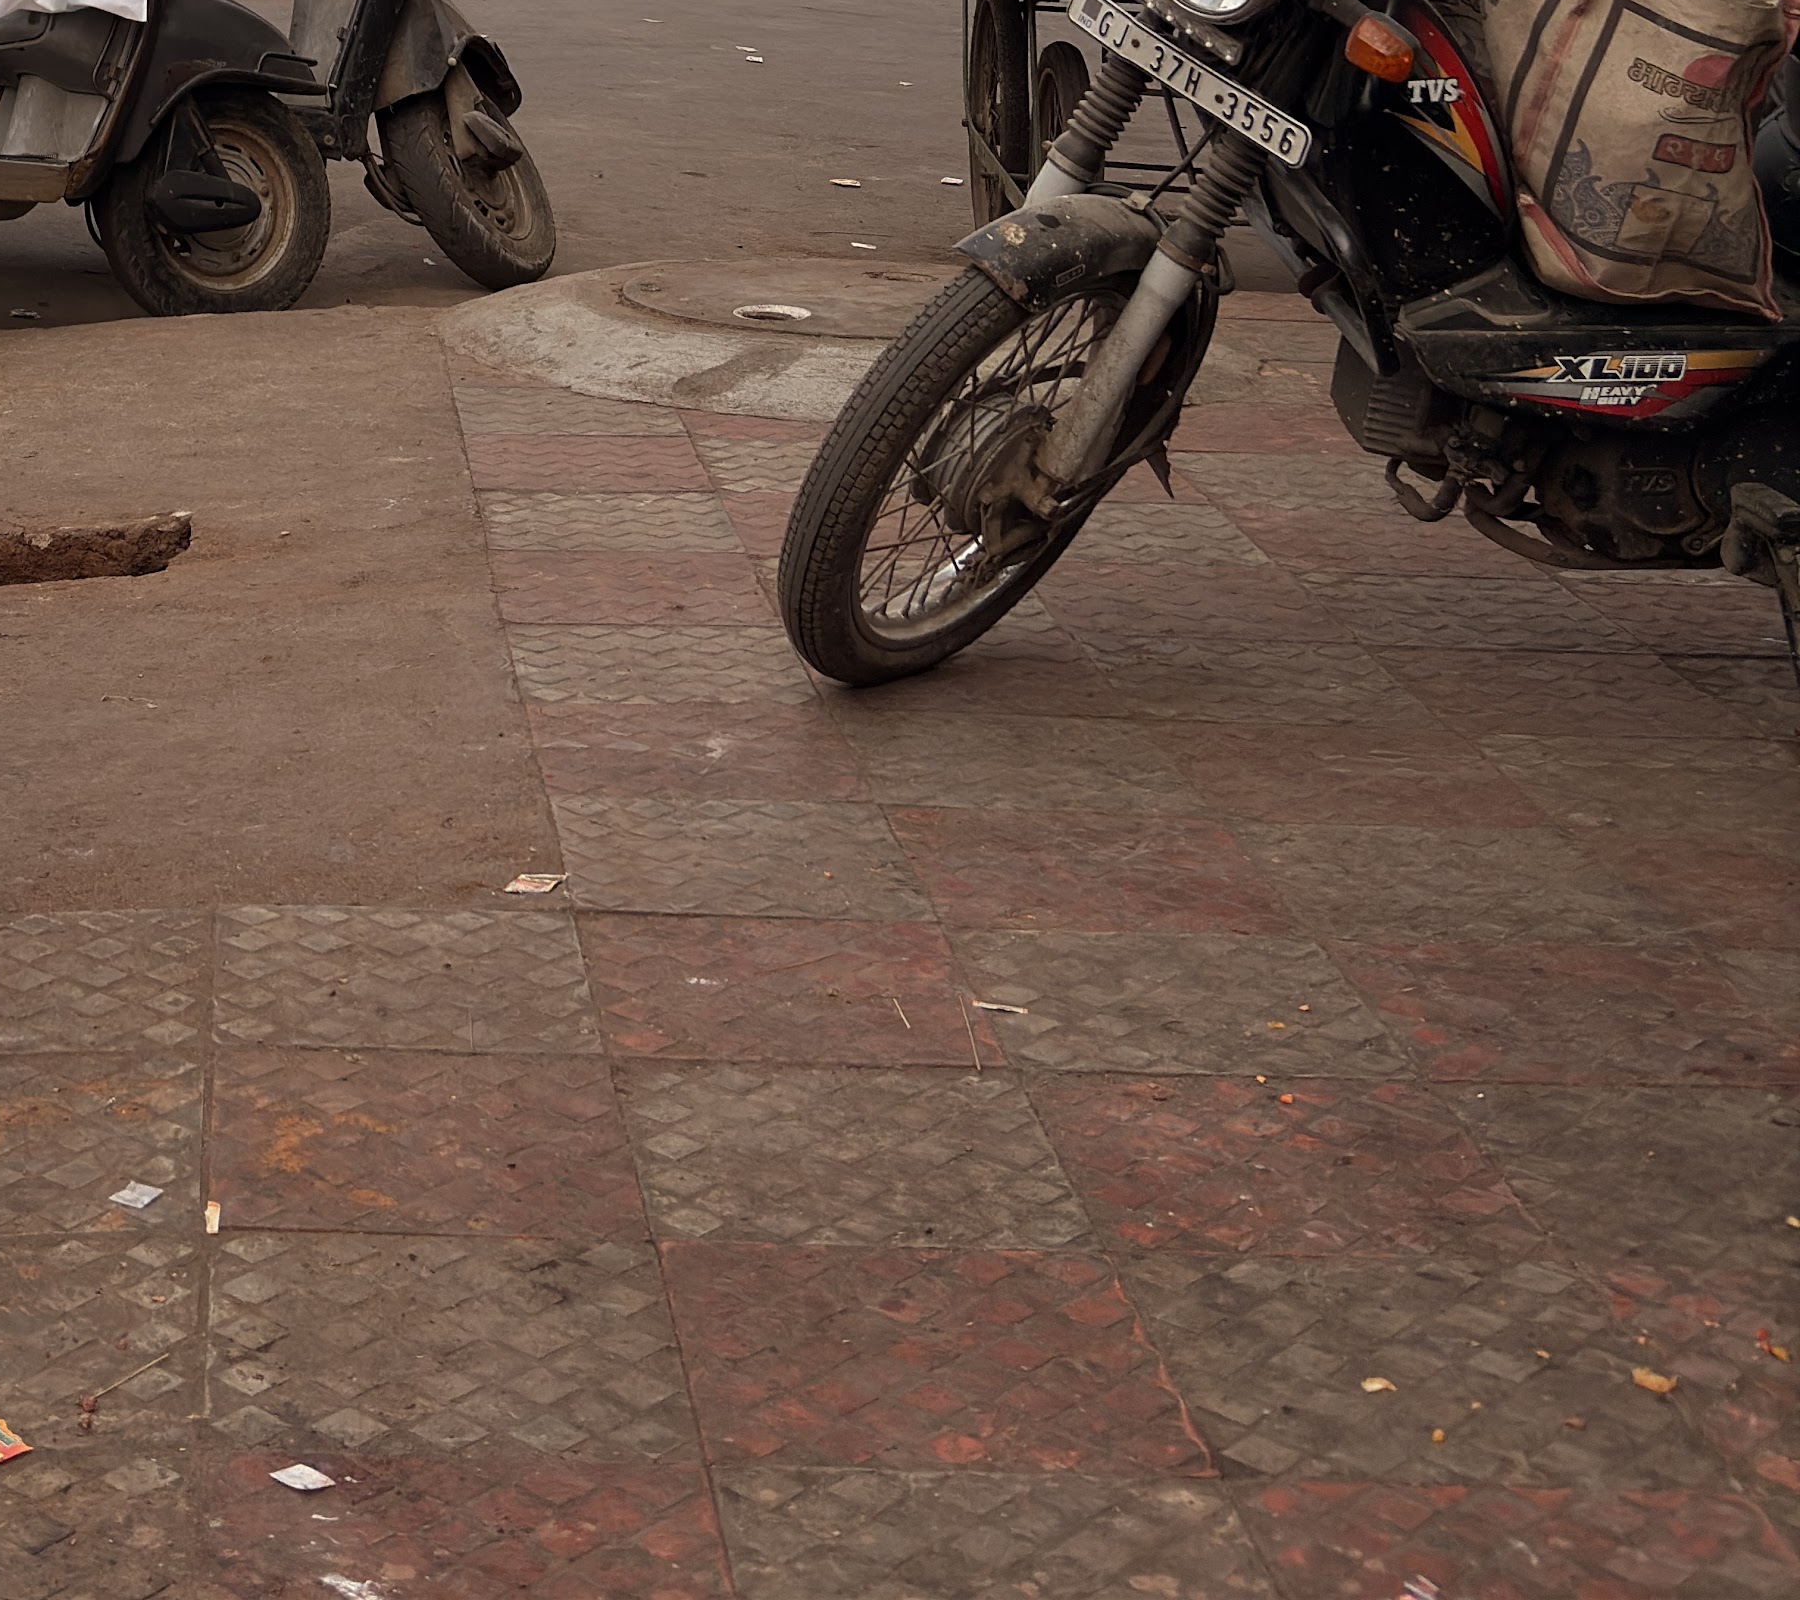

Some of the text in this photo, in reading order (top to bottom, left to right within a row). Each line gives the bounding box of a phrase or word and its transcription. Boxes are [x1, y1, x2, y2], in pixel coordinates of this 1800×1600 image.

[1077, 10, 1298, 156] IND GJ 37H 3556
[1406, 78, 1460, 104] TVS
[1546, 354, 1688, 383] XL100
[1580, 386, 1647, 401] HEAVY
